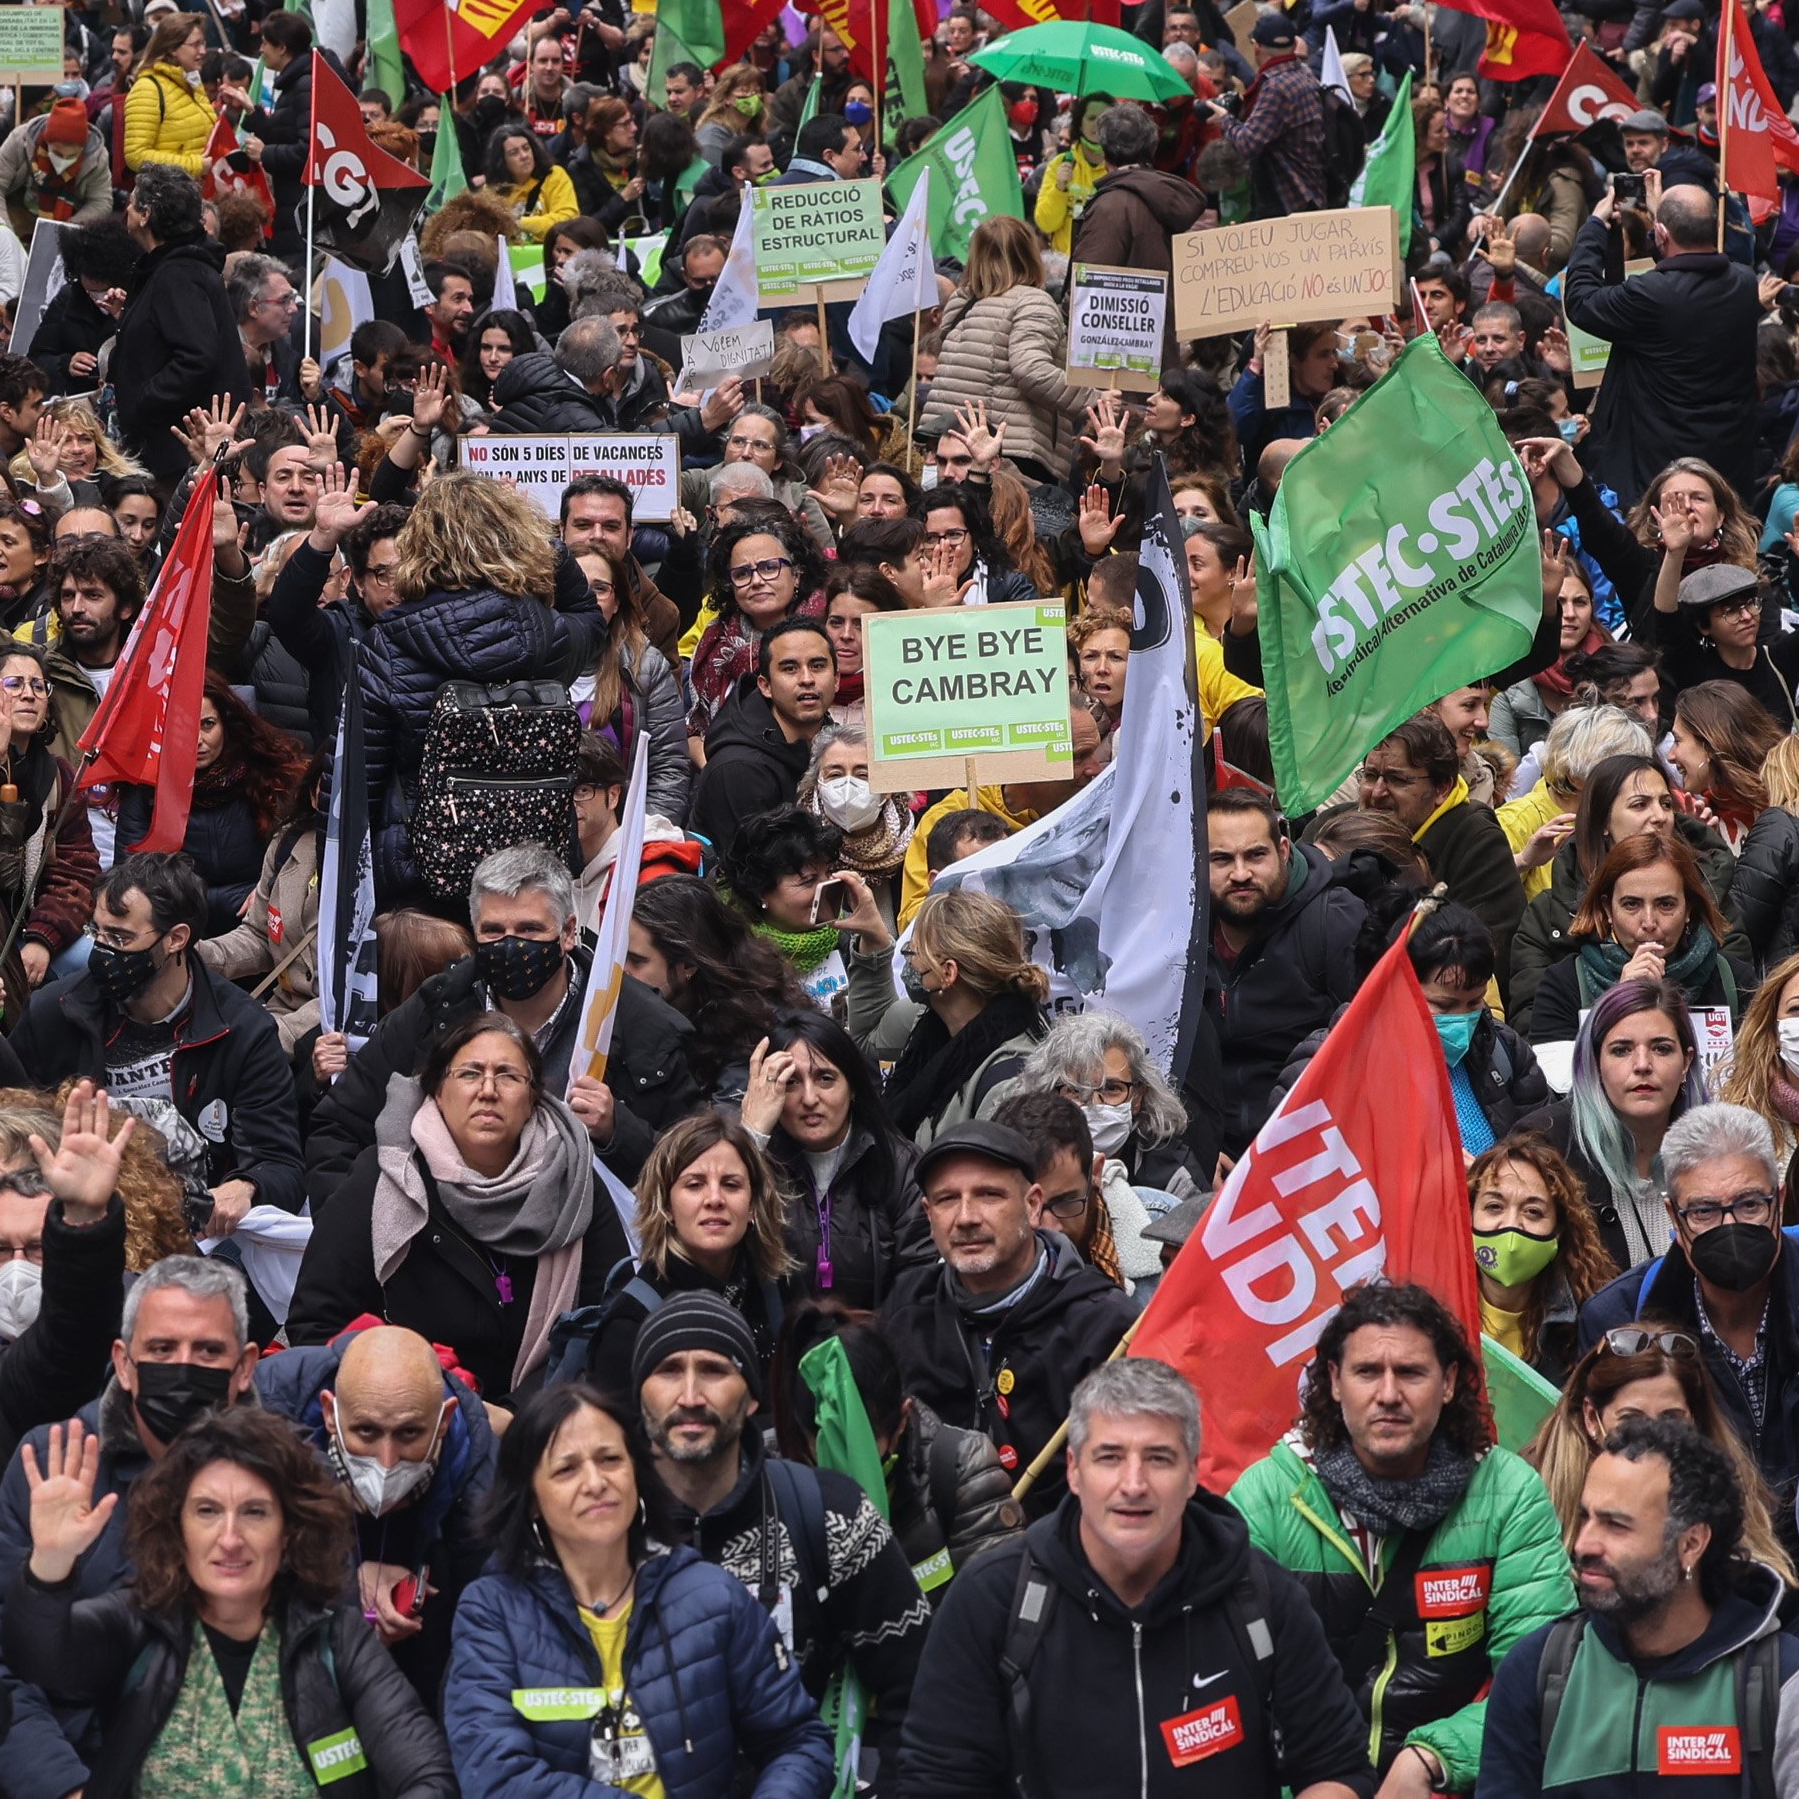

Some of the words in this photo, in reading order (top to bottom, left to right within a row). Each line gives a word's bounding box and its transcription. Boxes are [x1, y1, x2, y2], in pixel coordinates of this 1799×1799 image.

[770, 185, 861, 211] REDUCCIÓ
[772, 216, 799, 231] DE
[800, 207, 864, 227] RÀTIOS
[761, 227, 880, 252] ESTRUCTURAL
[1216, 226, 1274, 254] VOLEU
[1285, 218, 1352, 244] JUGAR
[1180, 252, 1291, 285] COMPREU-VOS
[1299, 248, 1323, 264] UN
[1200, 281, 1297, 317] L'EDUCACIÓ
[1300, 274, 1325, 301] NO
[1344, 275, 1362, 295] UN
[1362, 268, 1393, 296] JOC
[1088, 295, 1150, 315] DIMISSIÓ
[1080, 312, 1155, 334] CONSELLER
[1079, 333, 1154, 350] GONZÁLEZ-CAMBRAY
[469, 446, 488, 462] NO
[491, 443, 518, 462] SÓN
[523, 446, 532, 461] 5
[535, 442, 565, 461] DÍES
[573, 445, 591, 461] DE
[593, 444, 663, 461] VACANCES
[516, 470, 543, 484] ANYS
[550, 469, 567, 484] DE
[1379, 575, 1458, 638] Alternativa
[1459, 563, 1477, 584] de
[901, 632, 968, 665] BYE
[977, 627, 1044, 660] BYE
[891, 666, 1058, 706] CAMBRAY
[1707, 1011, 1727, 1022] UGT
[766, 1515, 775, 1573] COOLPIX
[1423, 1579, 1460, 1593] INTER
[1423, 1588, 1483, 1604] SINDICAL
[1172, 1717, 1213, 1742] INTER
[1174, 1719, 1236, 1751] SINDICAL
[1667, 1735, 1707, 1749] INTER
[1667, 1747, 1731, 1761] SINDICAL
